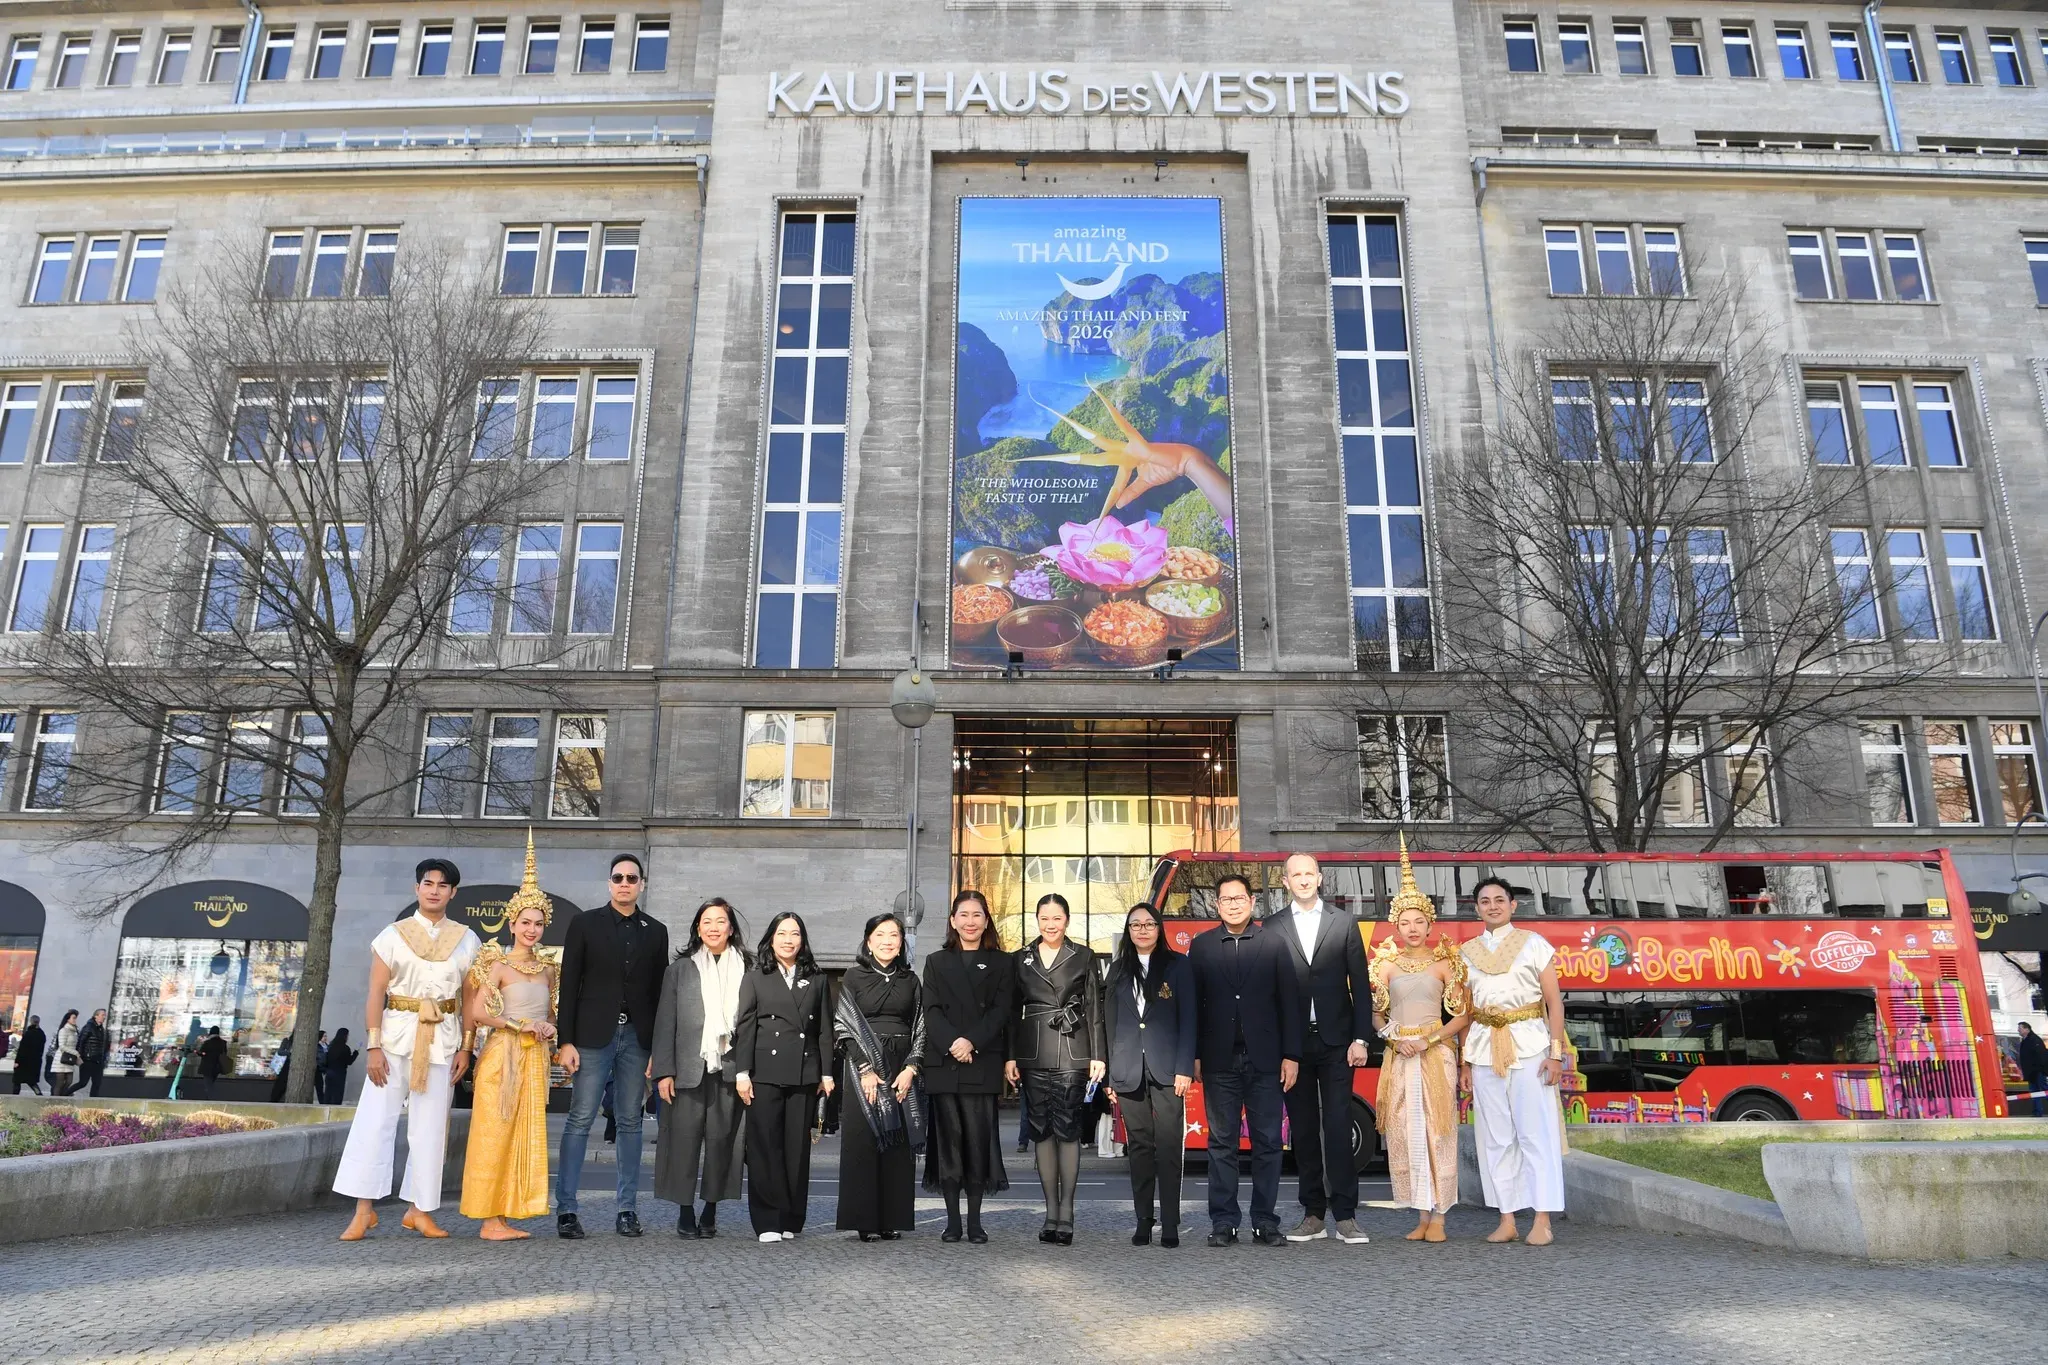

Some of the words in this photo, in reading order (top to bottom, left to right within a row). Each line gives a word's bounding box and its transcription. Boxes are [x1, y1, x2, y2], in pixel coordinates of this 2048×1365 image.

[767, 69, 1071, 117] KAUFHAUS
[1083, 84, 1151, 116] DES
[1151, 70, 1411, 117] WESTENS
[1053, 225, 1127, 241] amazing
[1011, 242, 1169, 263] THAILAND
[996, 311, 1069, 321] AMAZING
[1071, 311, 1152, 321] THAILAND
[1155, 311, 1190, 321] FEST
[1071, 325, 1114, 340] 2026
[974, 478, 1007, 489] "THE
[1010, 478, 1099, 489] WHOLESOME
[984, 493, 1025, 503] TASTE
[1028, 493, 1047, 503] OF
[1050, 493, 1090, 503] THAI"
[208, 894, 235, 903] amazing
[193, 901, 248, 912] THAILAND
[465, 906, 505, 917] THAILA
[1969, 906, 1992, 914] mazing
[1818, 943, 1872, 963] OFFICIAL
[1553, 945, 1609, 983] eing
[1638, 936, 1763, 983] Berlin
[1836, 957, 1860, 969] TOUR
